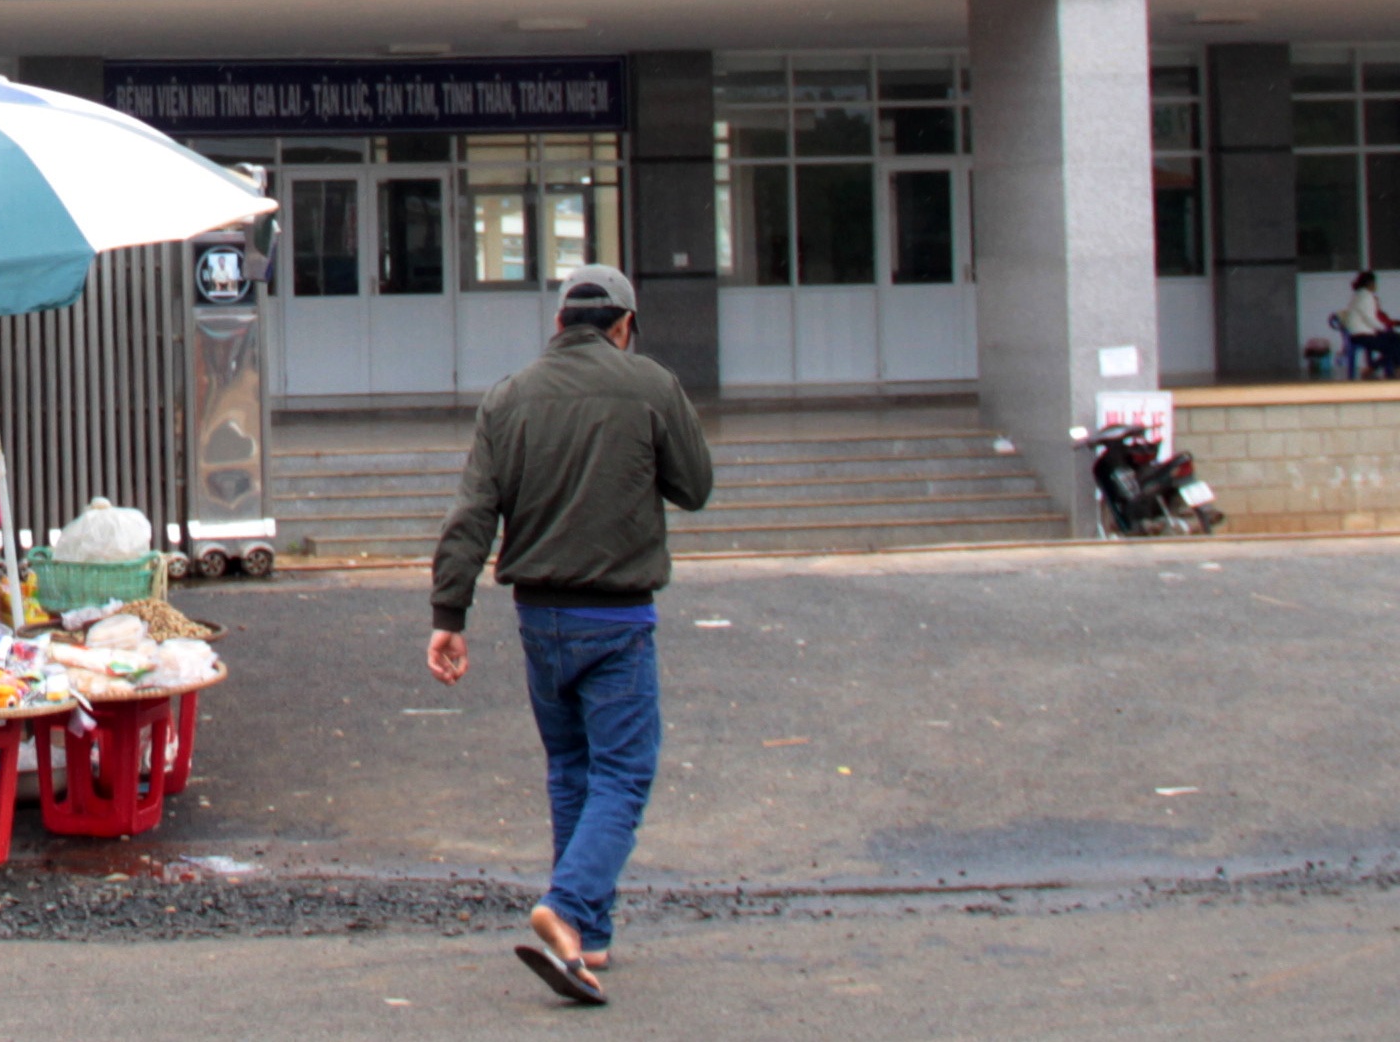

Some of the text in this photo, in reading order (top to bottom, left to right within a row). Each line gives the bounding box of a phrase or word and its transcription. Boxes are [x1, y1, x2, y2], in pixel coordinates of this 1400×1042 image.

[156, 76, 188, 123] VIỆN
[192, 84, 215, 116] NHI
[253, 84, 276, 116] GIA
[279, 84, 301, 116] LAI
[519, 72, 563, 113] TRÁCH
[566, 71, 609, 119] NHIỆM
